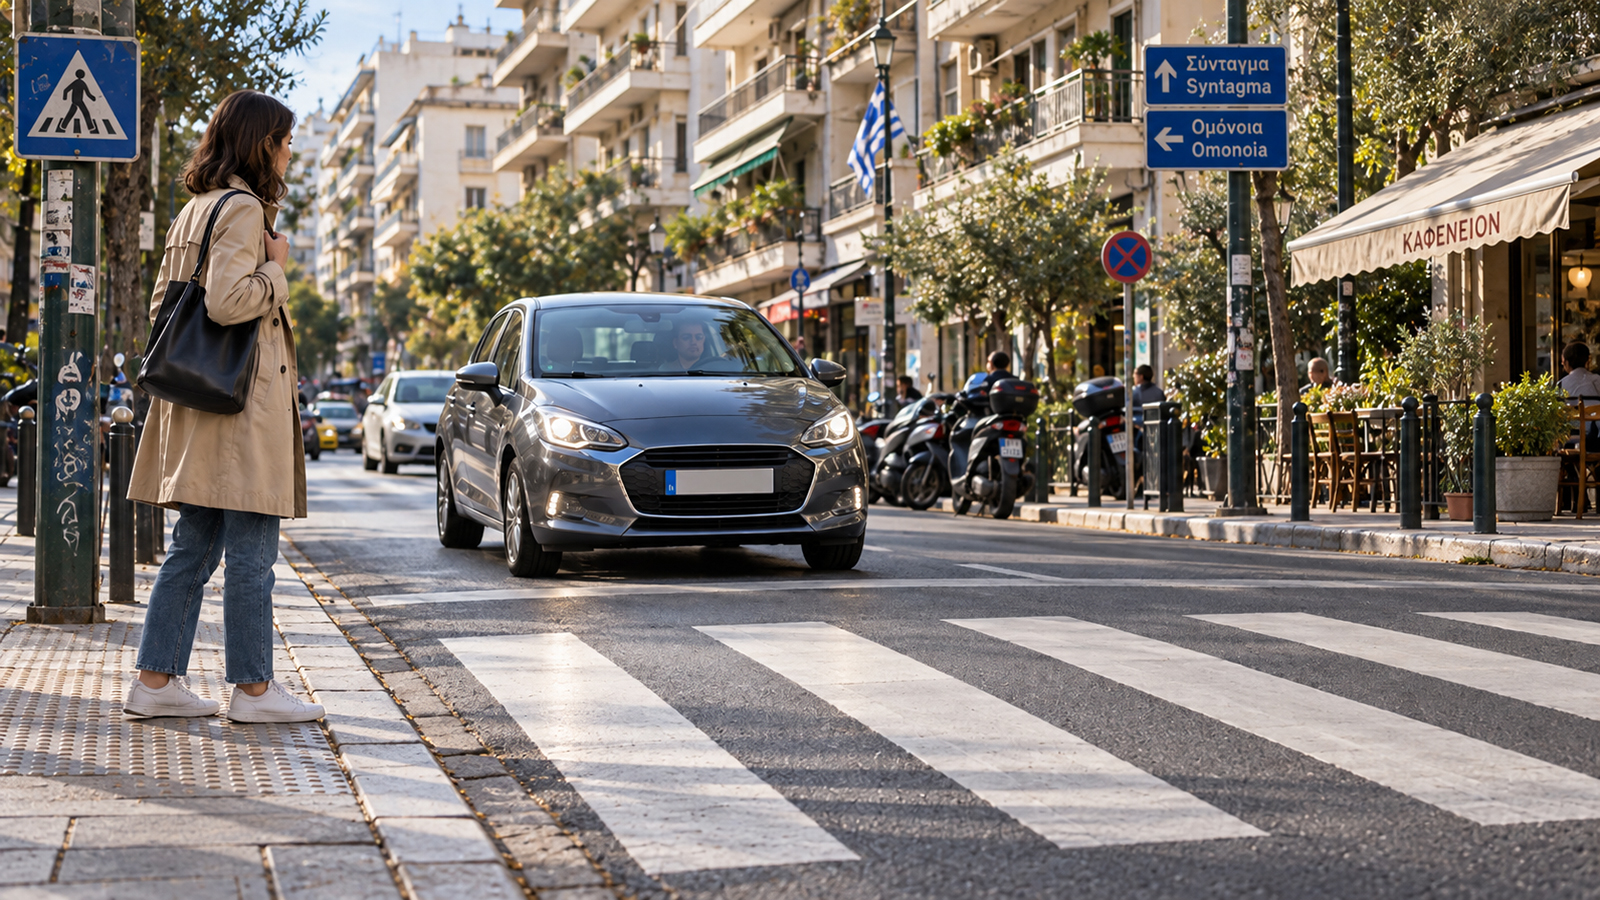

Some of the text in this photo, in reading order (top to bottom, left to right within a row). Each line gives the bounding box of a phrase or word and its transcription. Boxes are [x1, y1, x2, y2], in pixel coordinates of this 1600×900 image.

[1186, 55, 1269, 75] Σύνταγμα
[1186, 78, 1271, 98] Syntagma
[1192, 118, 1263, 138] Ομόνοια
[1192, 141, 1268, 157] Omonoia
[1403, 211, 1500, 254] ΚΑΦΕΝΕΙΟΝ
